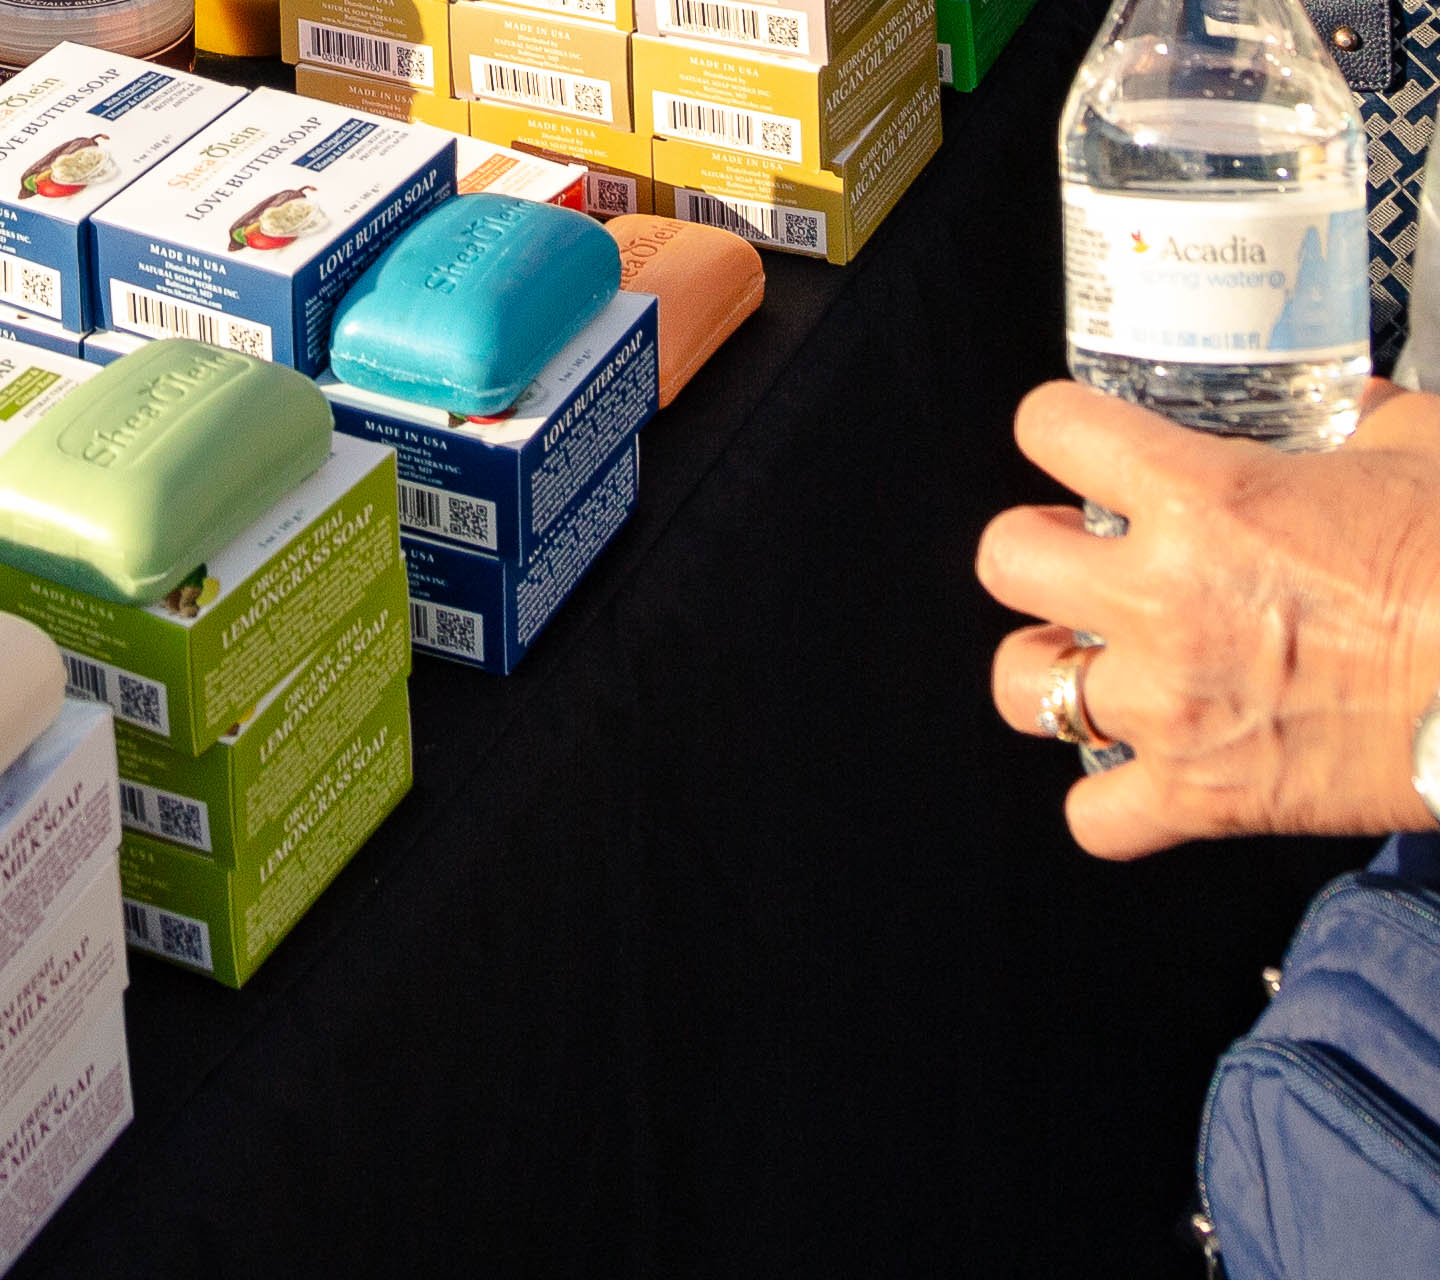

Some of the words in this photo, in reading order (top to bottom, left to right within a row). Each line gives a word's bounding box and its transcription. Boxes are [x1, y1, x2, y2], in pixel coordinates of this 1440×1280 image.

[20, 88, 82, 143] BUTTER
[77, 66, 122, 104] SOAP
[1160, 234, 1266, 264] Acadia
